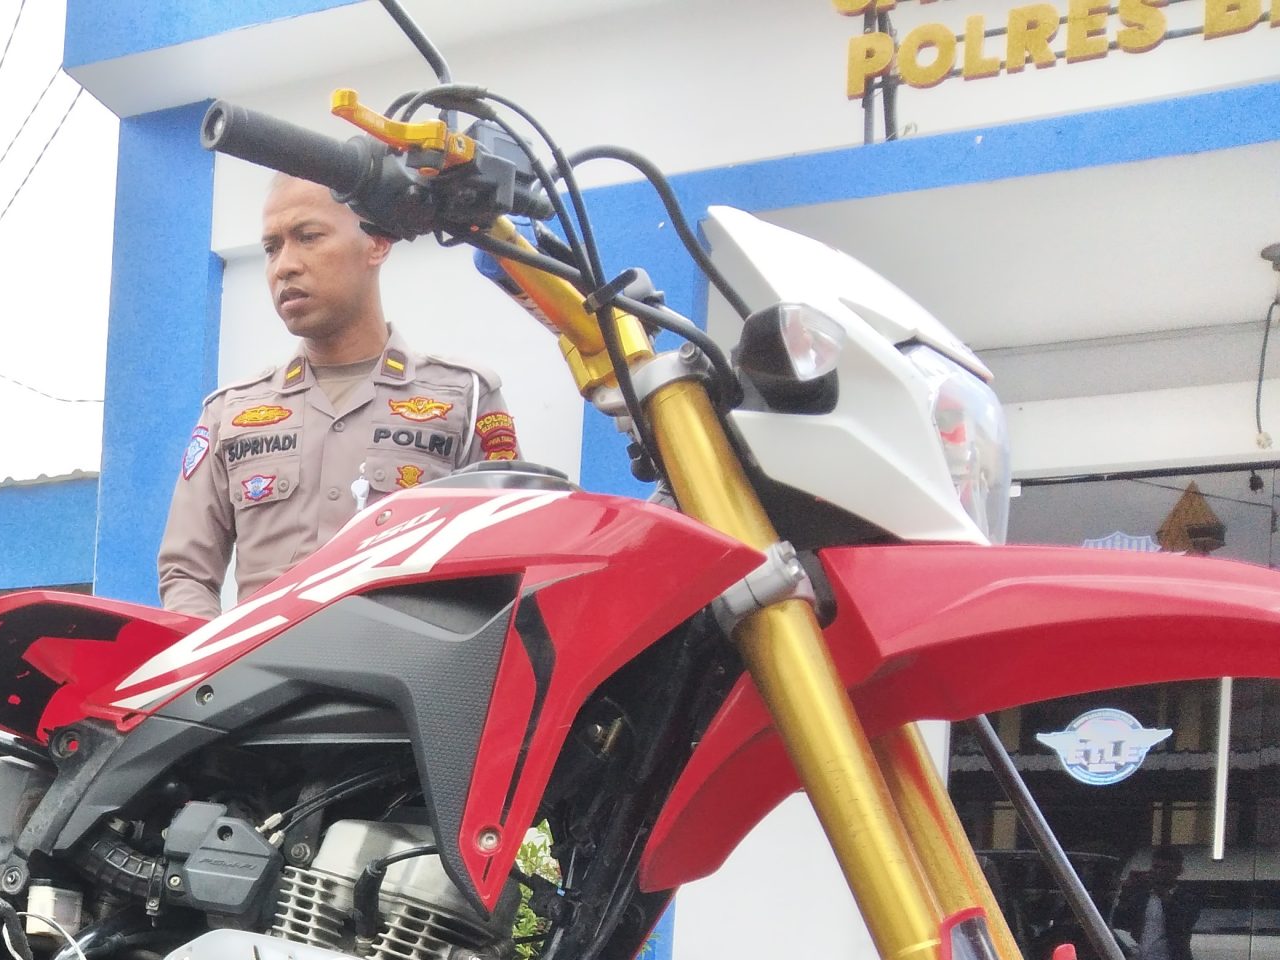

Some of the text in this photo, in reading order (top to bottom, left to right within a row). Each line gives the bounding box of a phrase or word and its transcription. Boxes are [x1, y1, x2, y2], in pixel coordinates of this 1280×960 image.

[847, 0, 1167, 100] POLRES
[228, 433, 298, 462] SUPRIYADI
[373, 428, 453, 456] POLRI
